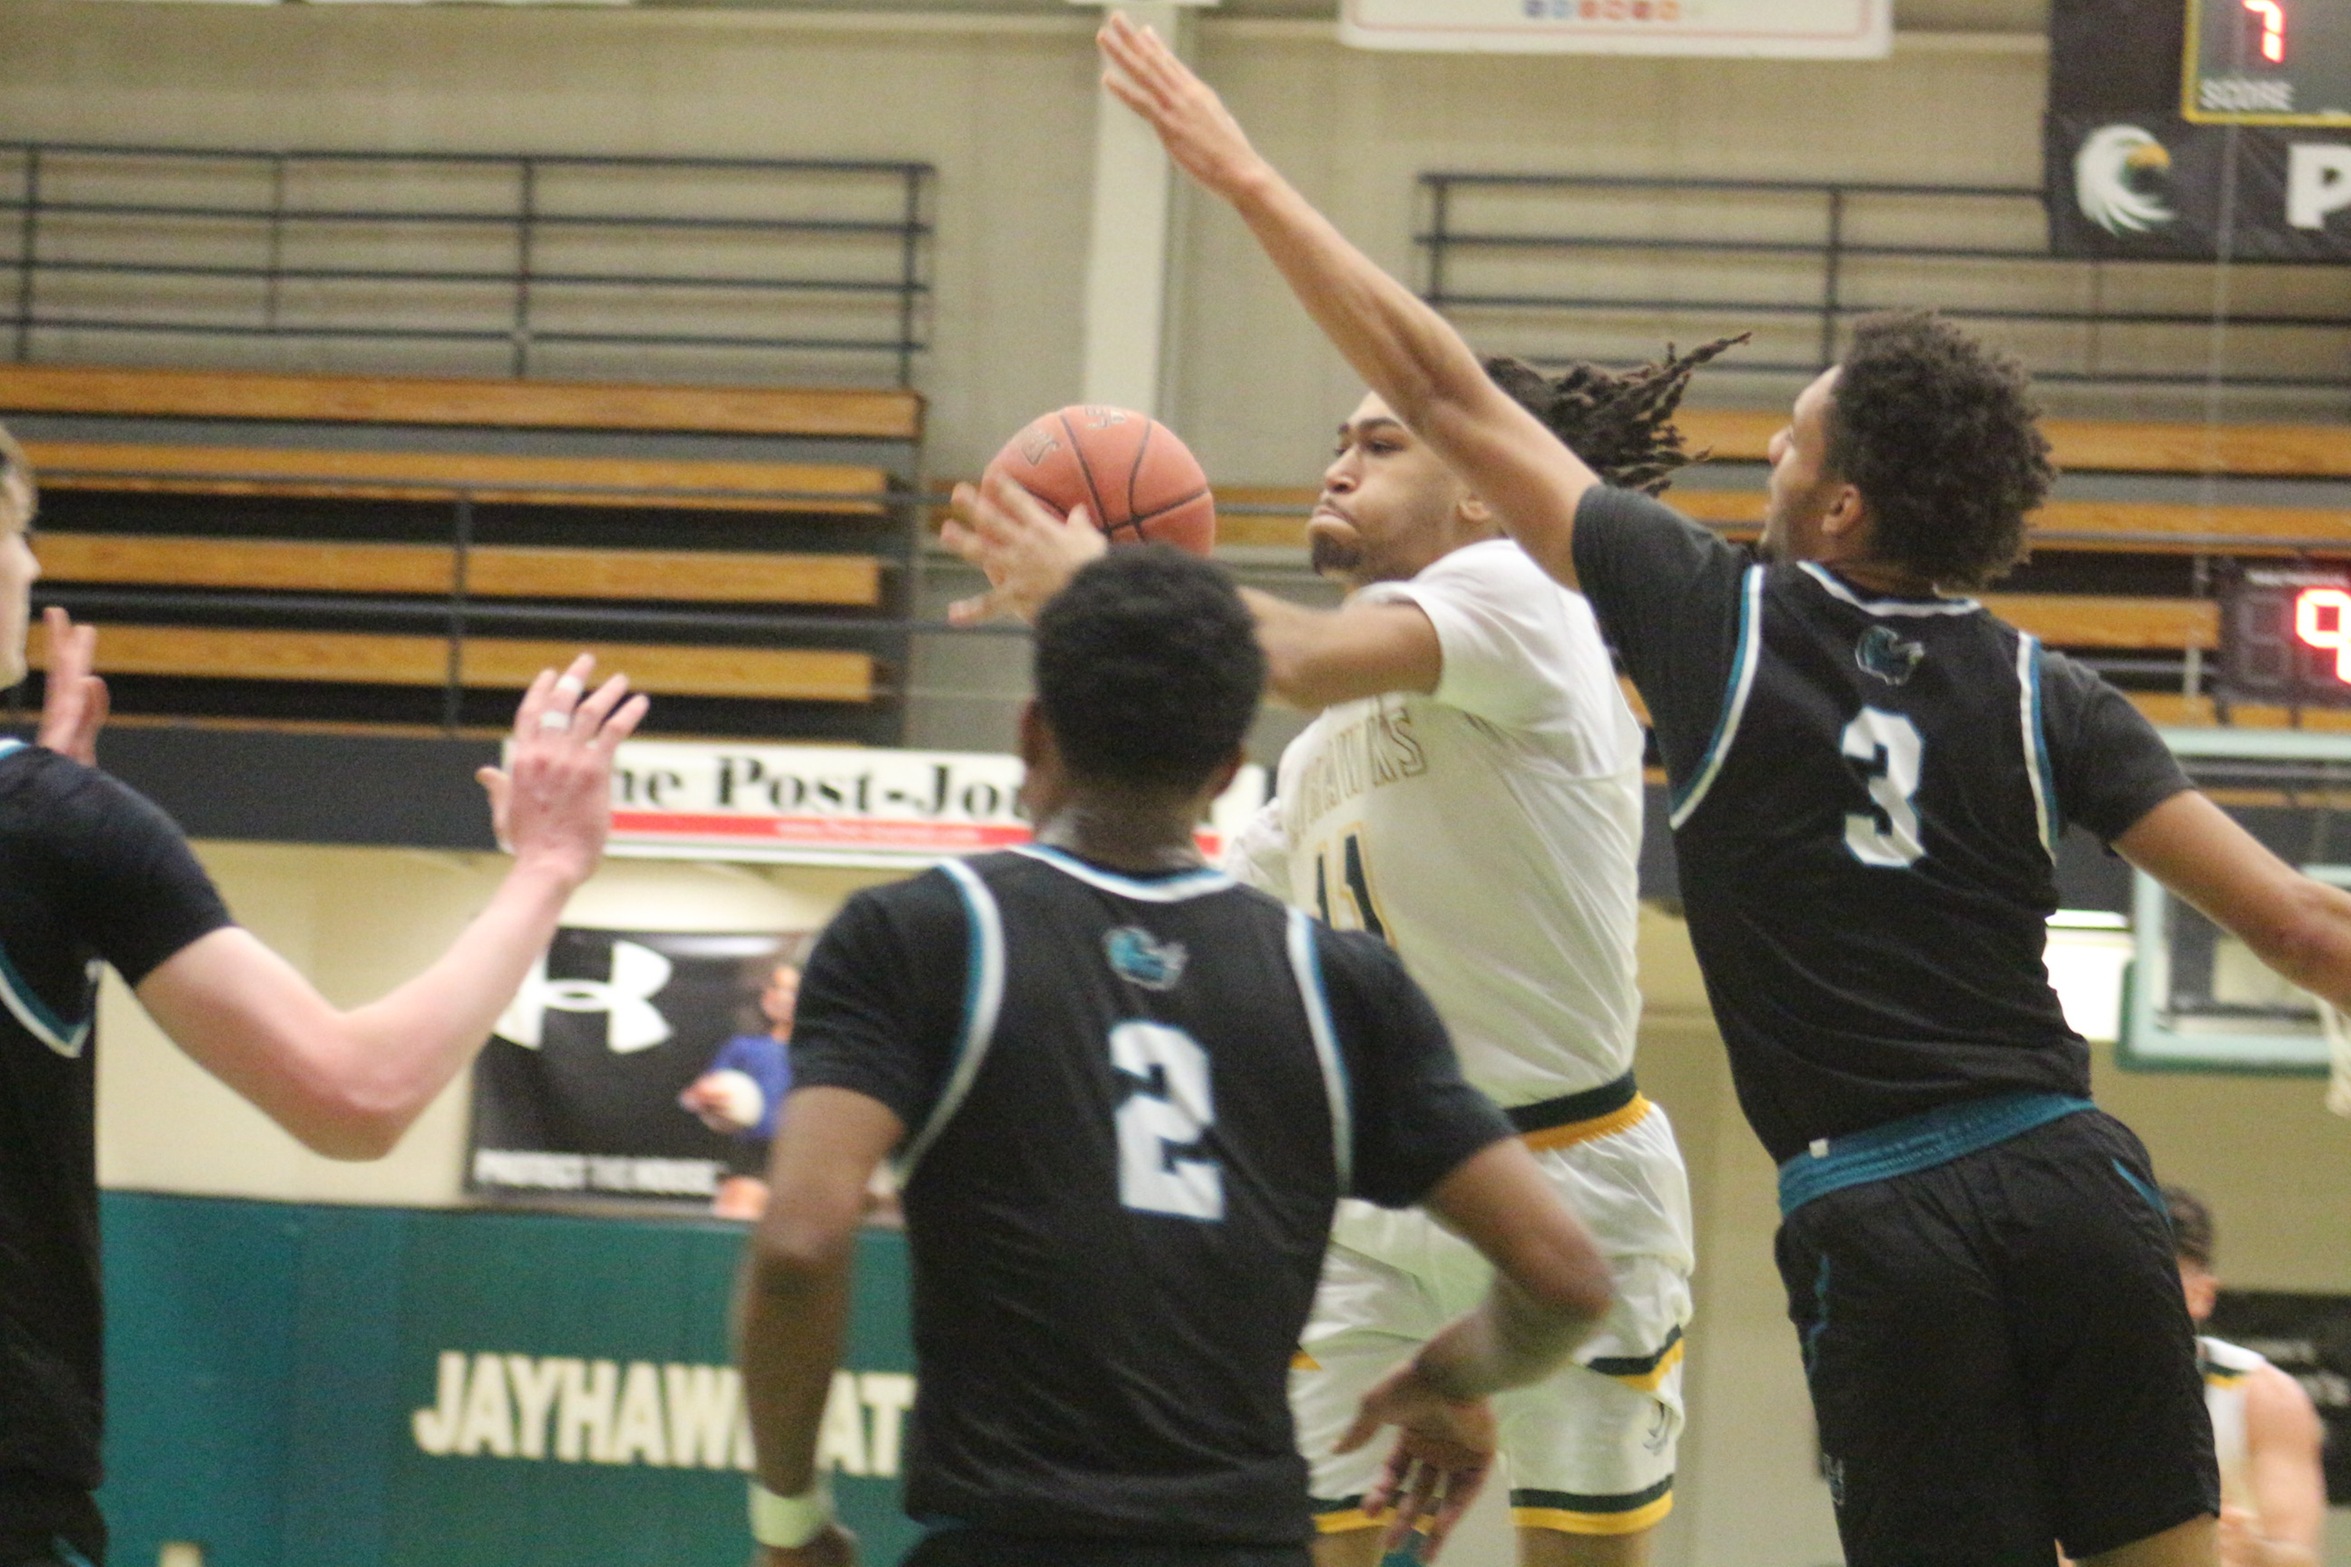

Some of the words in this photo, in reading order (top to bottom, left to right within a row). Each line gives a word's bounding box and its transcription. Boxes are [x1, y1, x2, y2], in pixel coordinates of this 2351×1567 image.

[2241, 0, 2286, 63] 7
[2295, 587, 2351, 685] 9
[1840, 705, 1926, 868] 3
[1108, 1020, 1225, 1223] 2
